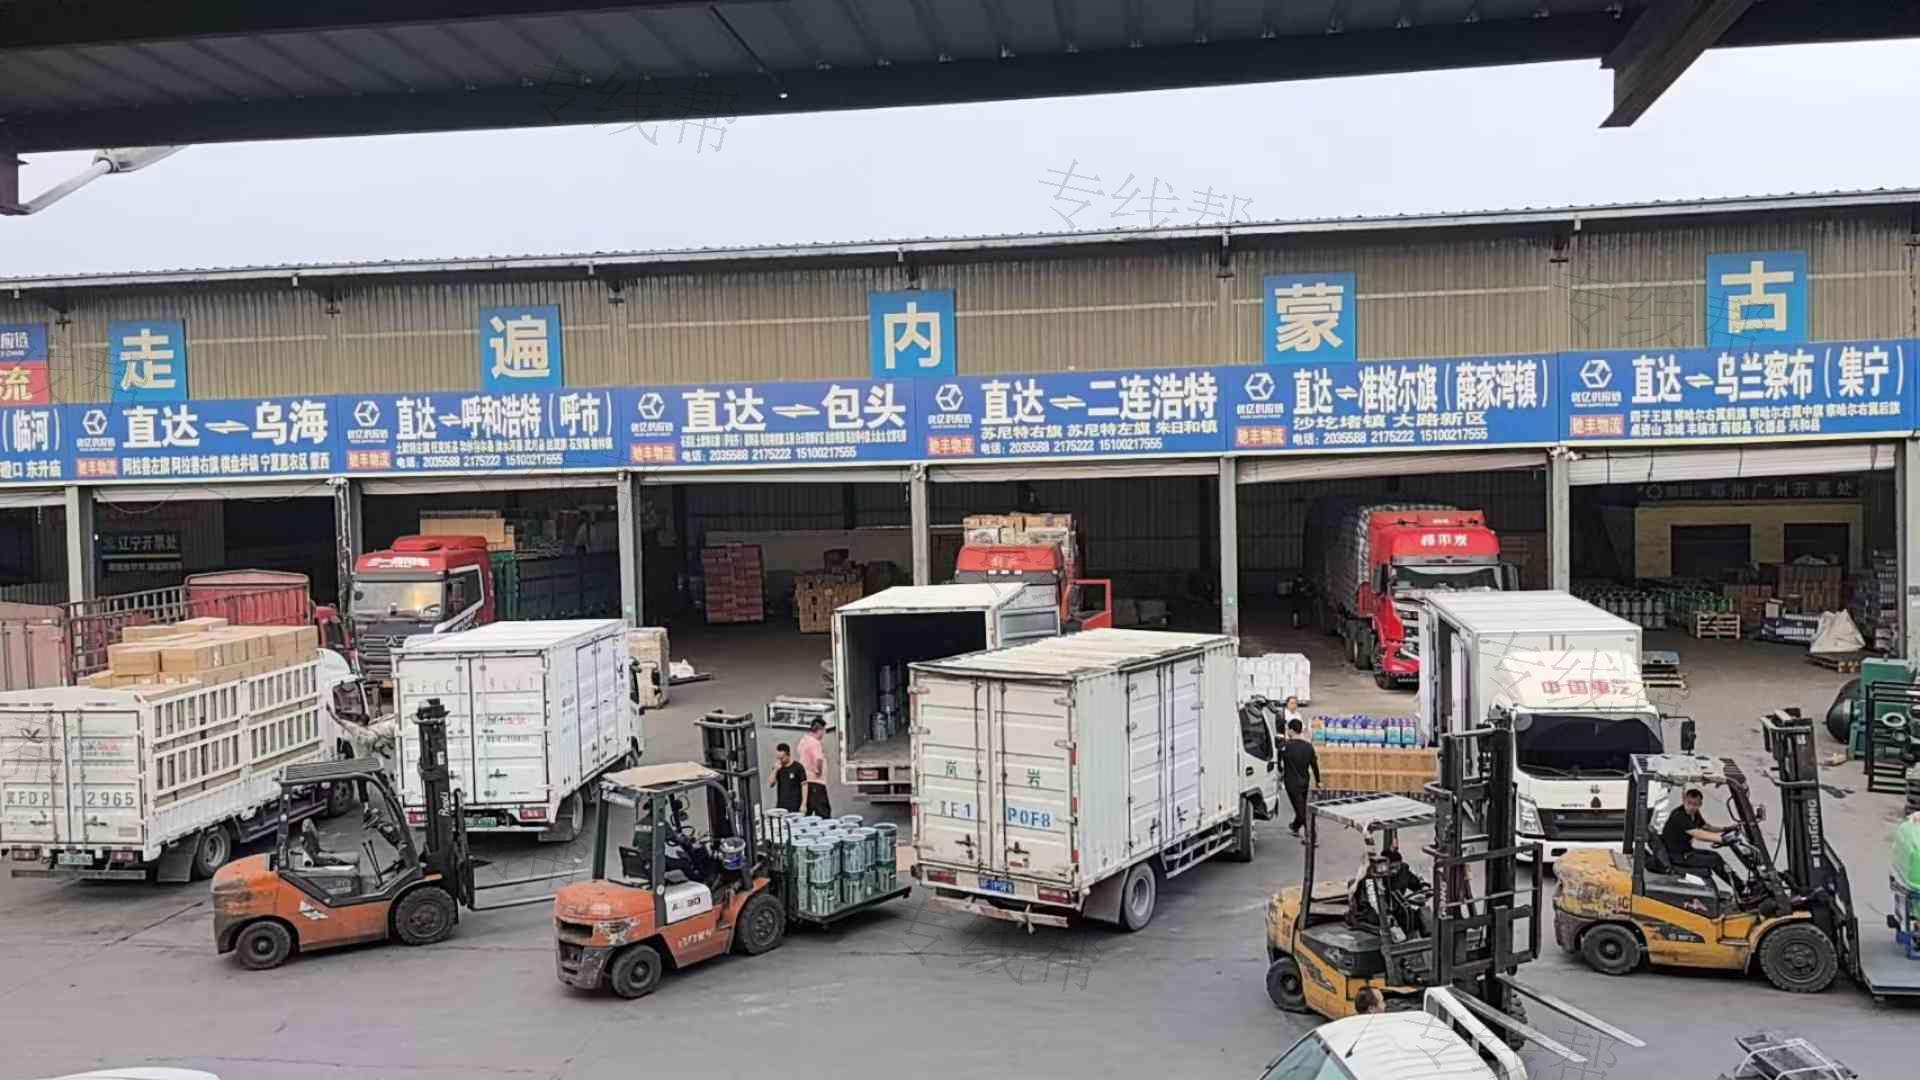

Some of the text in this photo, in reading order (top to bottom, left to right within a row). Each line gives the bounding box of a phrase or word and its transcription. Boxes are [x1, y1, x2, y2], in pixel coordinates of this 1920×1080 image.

[120, 260, 1796, 391] 走 遍 内 蒙 古
[980, 372, 1218, 425] 直达 二连浩特
[1293, 368, 1333, 415] 直达
[1632, 354, 1682, 404] 直达
[122, 400, 328, 449] 直达 乌海
[396, 396, 437, 440] 直达
[682, 383, 907, 433] 直达 包头
[1393, 410, 1488, 427] 大路新区
[752, 447, 792, 460] 2175222
[980, 425, 1062, 441] 苏尼特右旗
[1066, 422, 1150, 438] 苏尼特左旗
[1009, 441, 1050, 454] 2035588
[1054, 440, 1094, 453] 2175222
[1099, 438, 1162, 452] 15100217555
[1323, 430, 1366, 444] 2035588
[1370, 429, 1414, 443] 2175222
[1420, 428, 1488, 442] 15100217555
[86, 791, 135, 807] 2965
